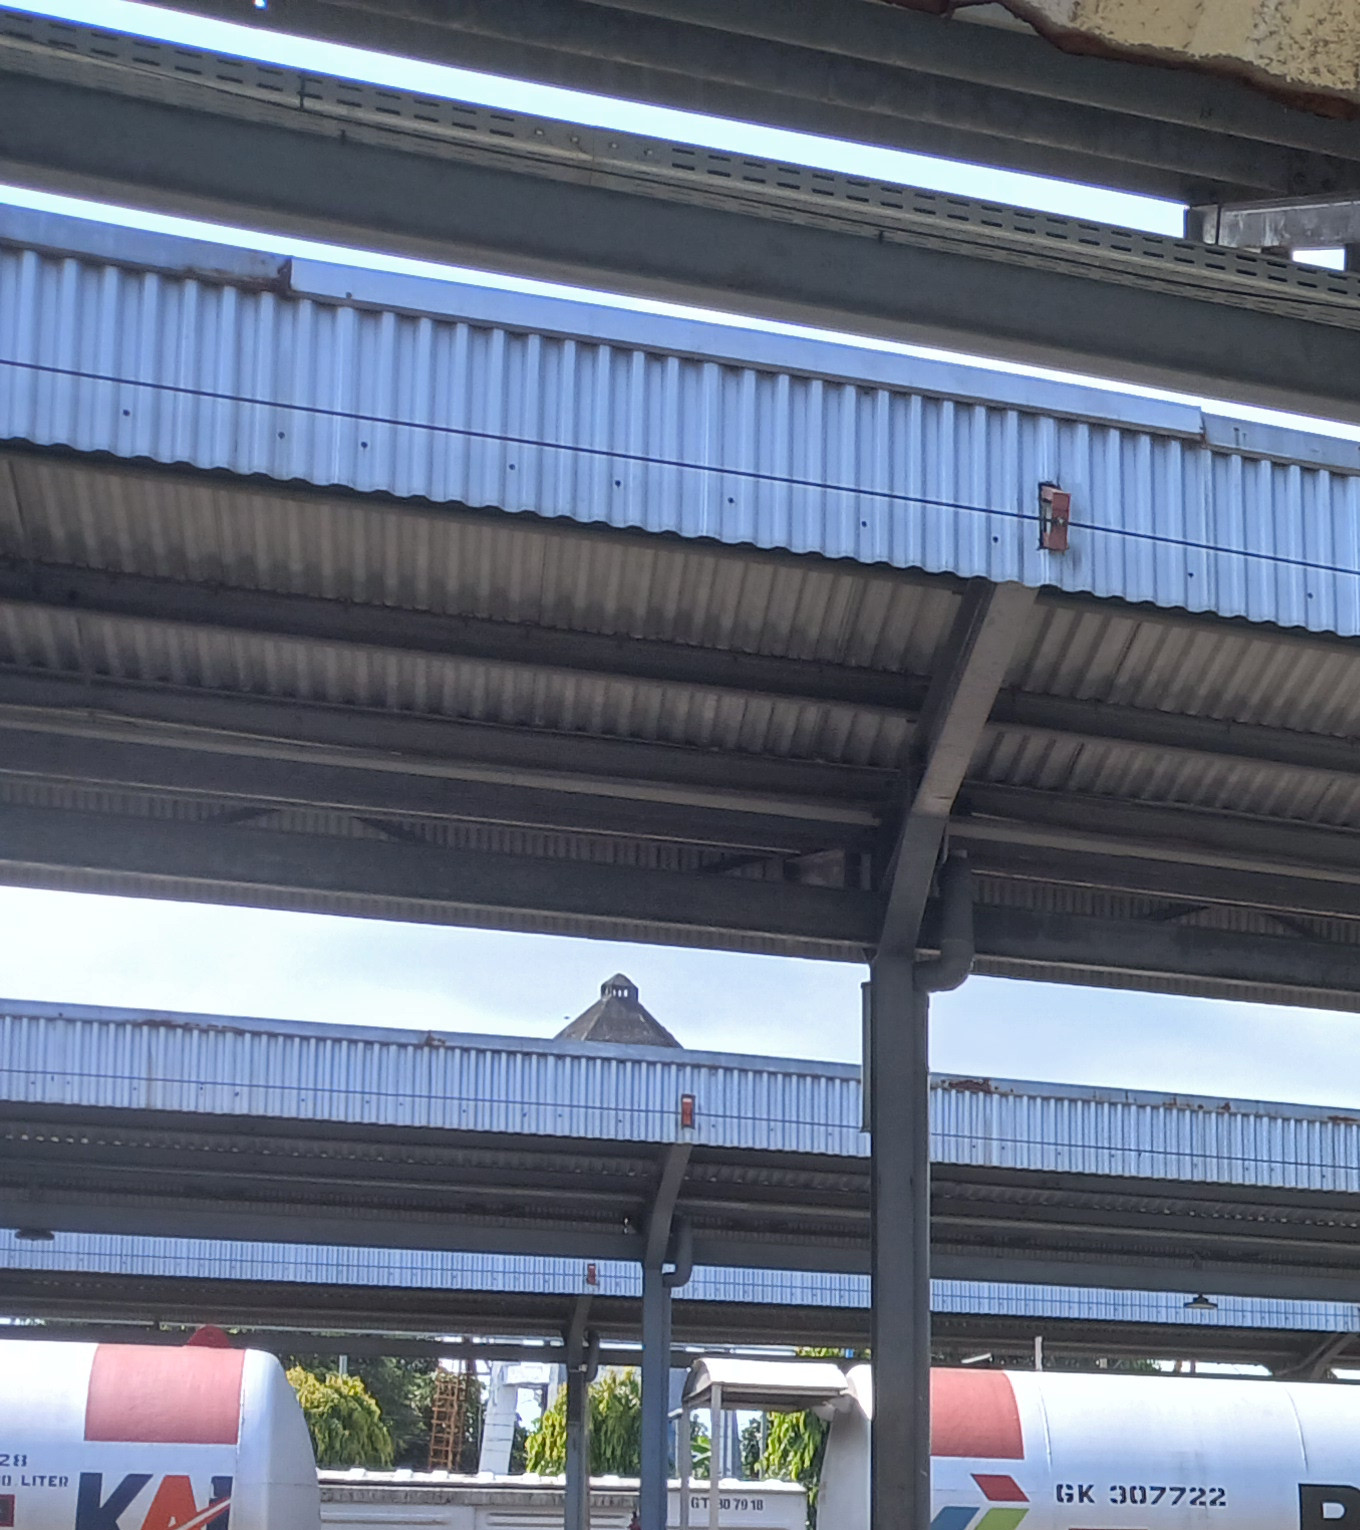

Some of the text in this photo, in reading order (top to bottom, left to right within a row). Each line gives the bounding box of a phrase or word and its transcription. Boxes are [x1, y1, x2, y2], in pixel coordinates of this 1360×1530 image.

[21, 1475, 69, 1487] LITER
[1056, 1484, 1227, 1507] GK 307722
